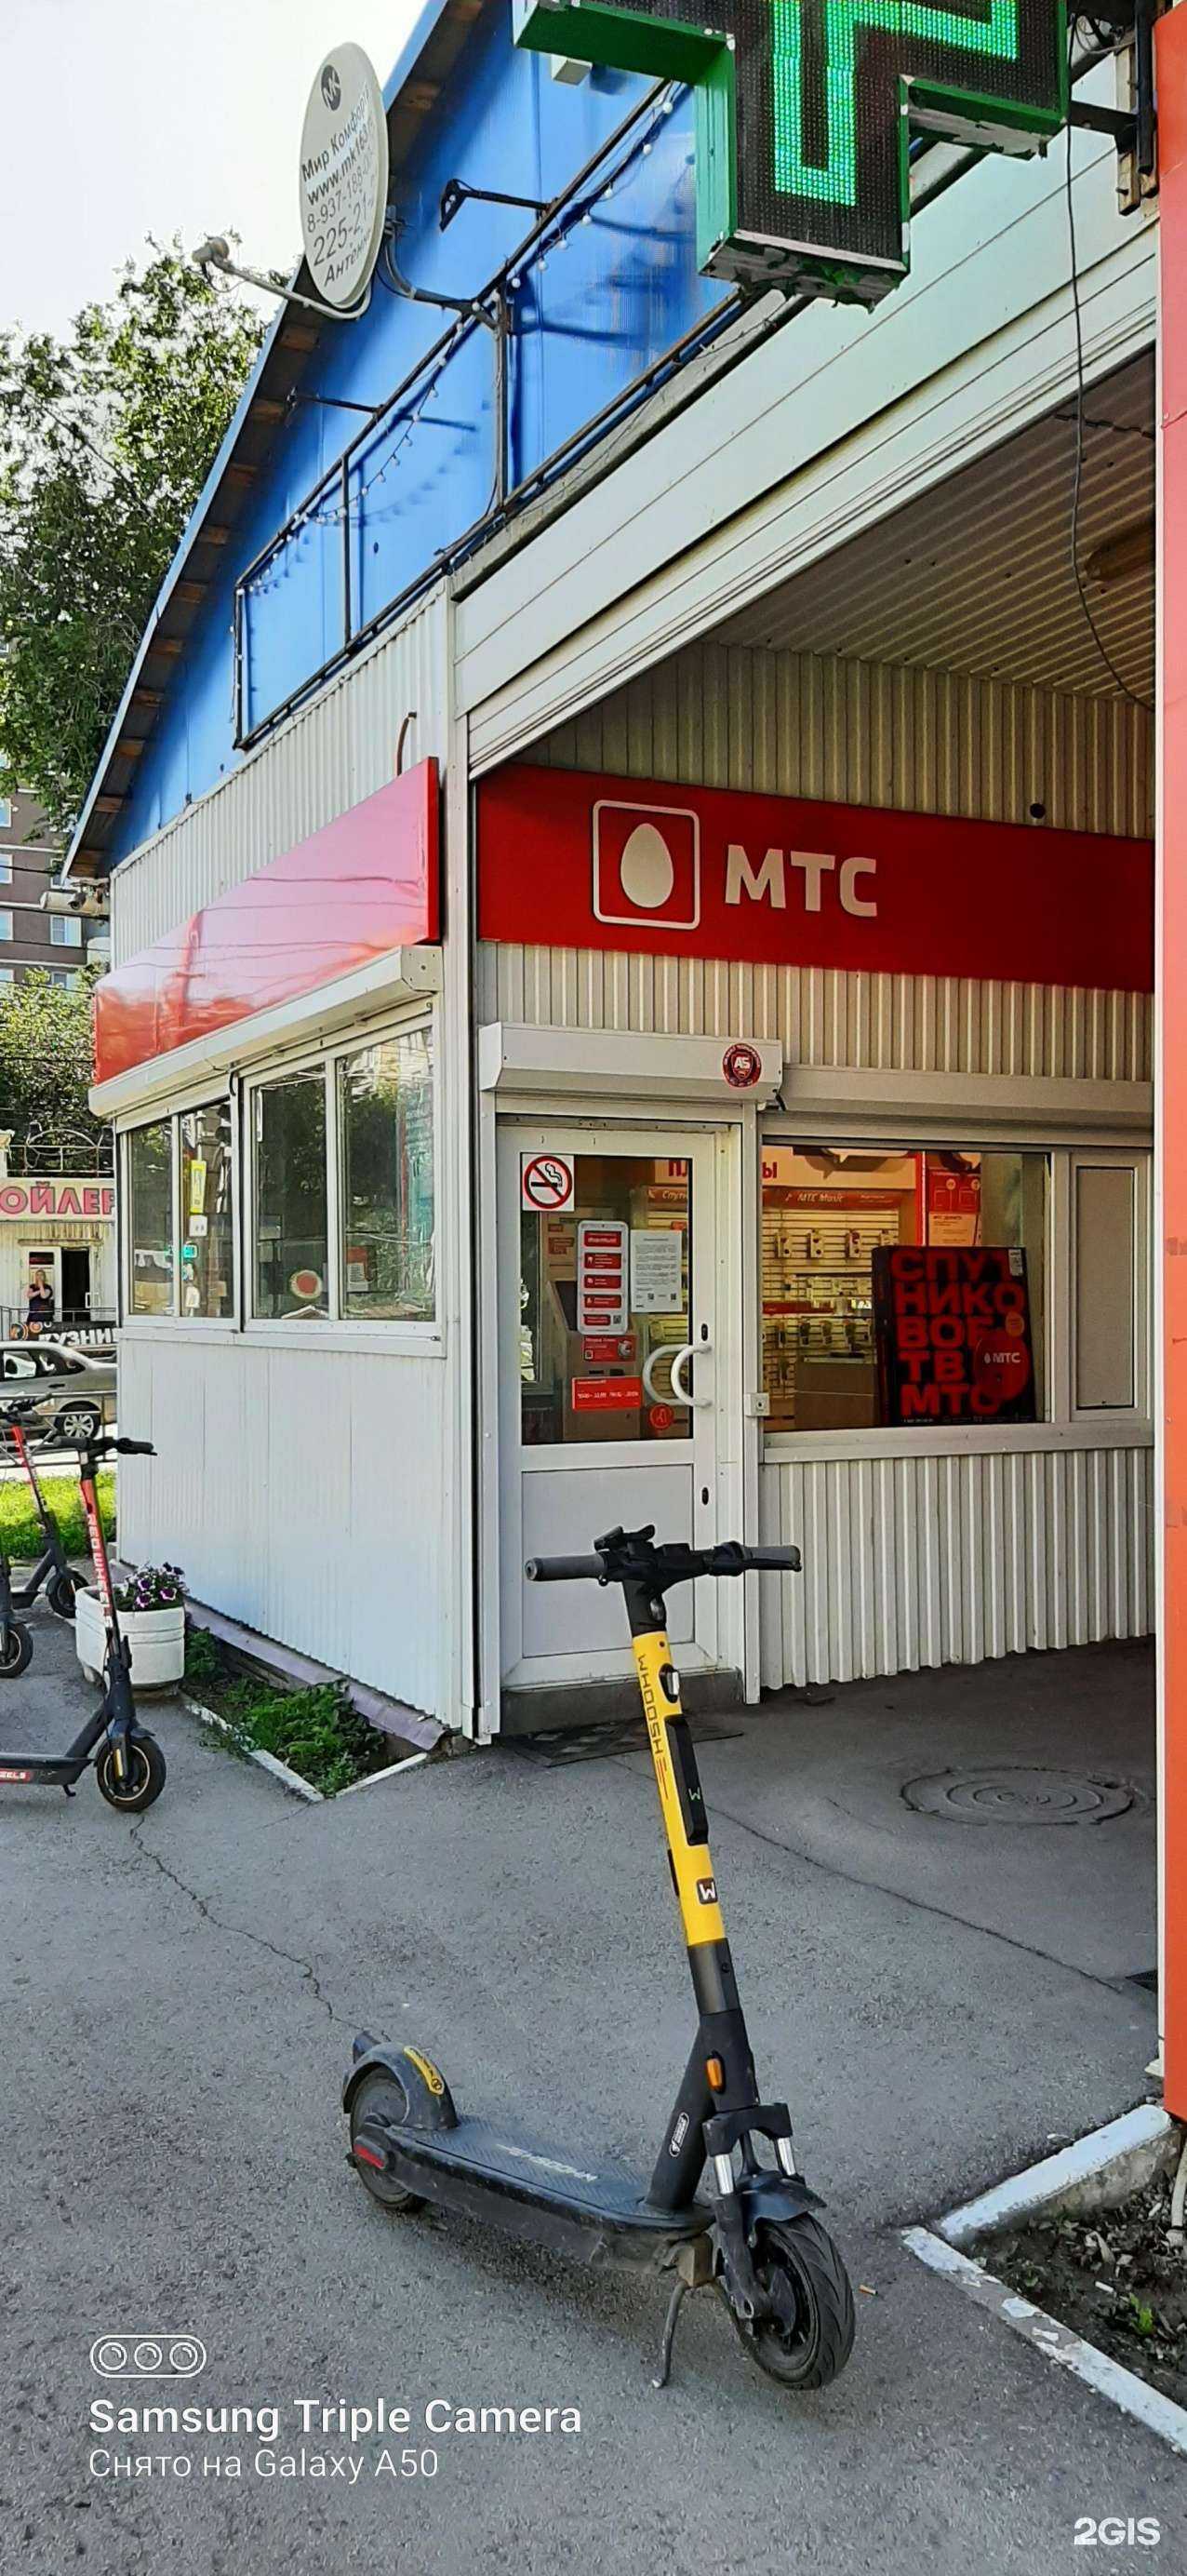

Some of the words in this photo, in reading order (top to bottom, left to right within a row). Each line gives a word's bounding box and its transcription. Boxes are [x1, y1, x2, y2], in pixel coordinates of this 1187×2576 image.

[301, 150, 329, 182] Мир
[724, 844, 877, 918] МТС
[895, 1281, 1024, 1315] НИКО
[899, 1350, 966, 1382] ТВ
[993, 1352, 1021, 1364] МТС
[637, 1653, 663, 1754] WHOOSH
[699, 1881, 716, 1901] W
